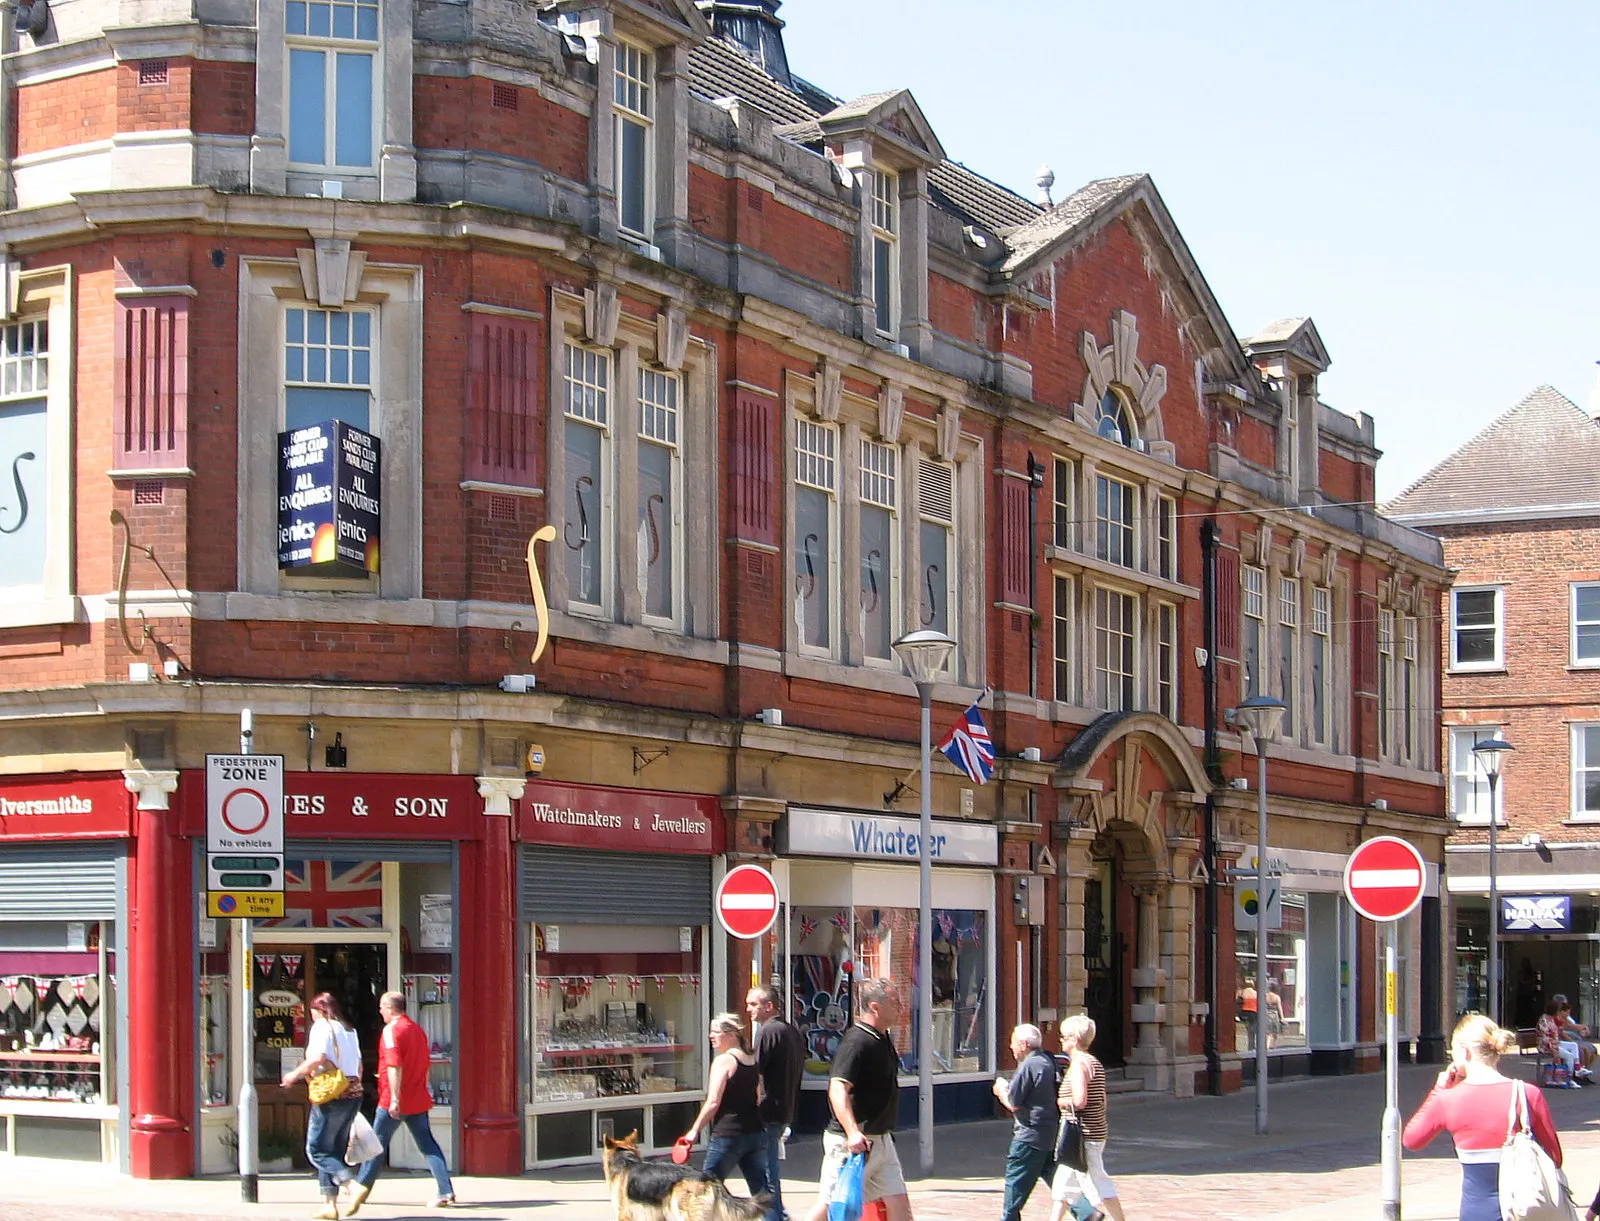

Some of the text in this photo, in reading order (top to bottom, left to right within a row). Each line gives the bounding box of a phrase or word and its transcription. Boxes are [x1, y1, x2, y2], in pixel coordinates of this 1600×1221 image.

[348, 429, 371, 449] FORMER
[362, 448, 376, 463] CLUB
[345, 452, 374, 475] AVAILABLE
[295, 473, 314, 491] ALL
[352, 475, 366, 494] ALL
[280, 485, 332, 511] ENQUIRIES
[339, 487, 379, 515] ENQUIRIES
[278, 519, 315, 549] jenics
[337, 514, 367, 543] jenics
[213, 758, 277, 767] PEDESTRIAN
[222, 768, 267, 780] ZONE
[351, 796, 369, 816] &
[394, 797, 449, 818] SON
[531, 802, 706, 834] Watchmakers & Jewellers
[219, 839, 272, 848] No vehicles
[245, 895, 275, 905] At any
[250, 905, 270, 913] time
[1504, 908, 1565, 920] HALIFAX
[268, 994, 291, 1004] OPEN
[255, 1007, 304, 1019] BARNES
[273, 1020, 285, 1034] &
[267, 1038, 292, 1048] SON
